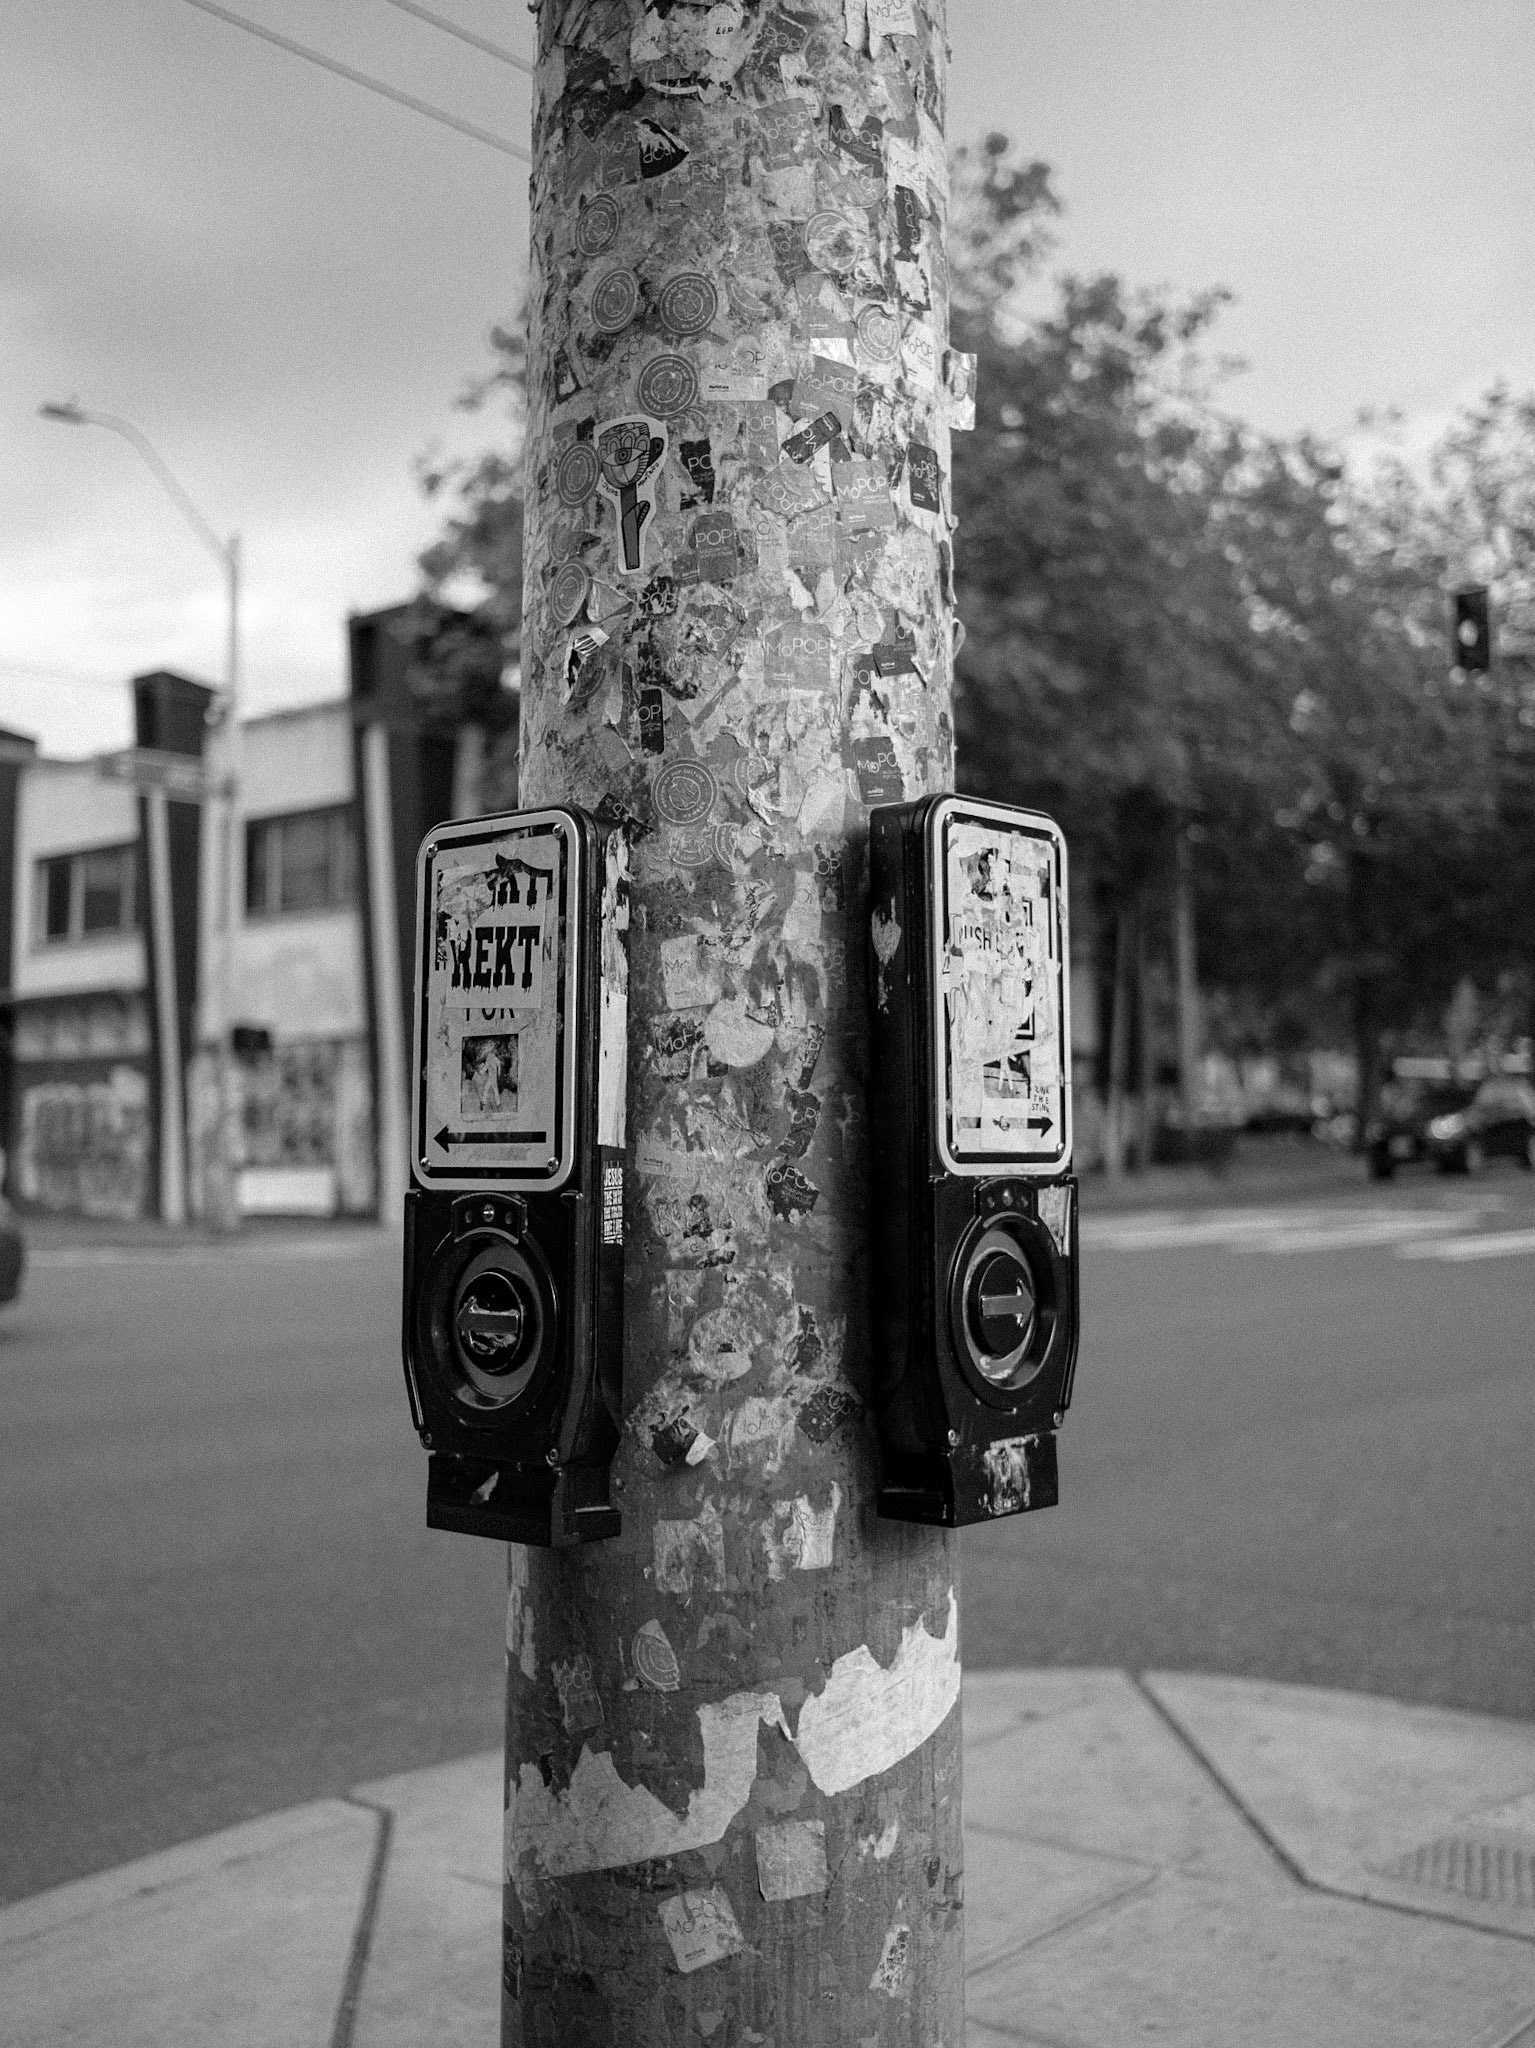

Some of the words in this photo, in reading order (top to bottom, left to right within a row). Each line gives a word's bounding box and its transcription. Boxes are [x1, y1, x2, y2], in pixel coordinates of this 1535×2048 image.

[836, 476, 887, 499] MoPOP
[766, 637, 829, 657] MoPOP
[450, 926, 540, 991] REKT
